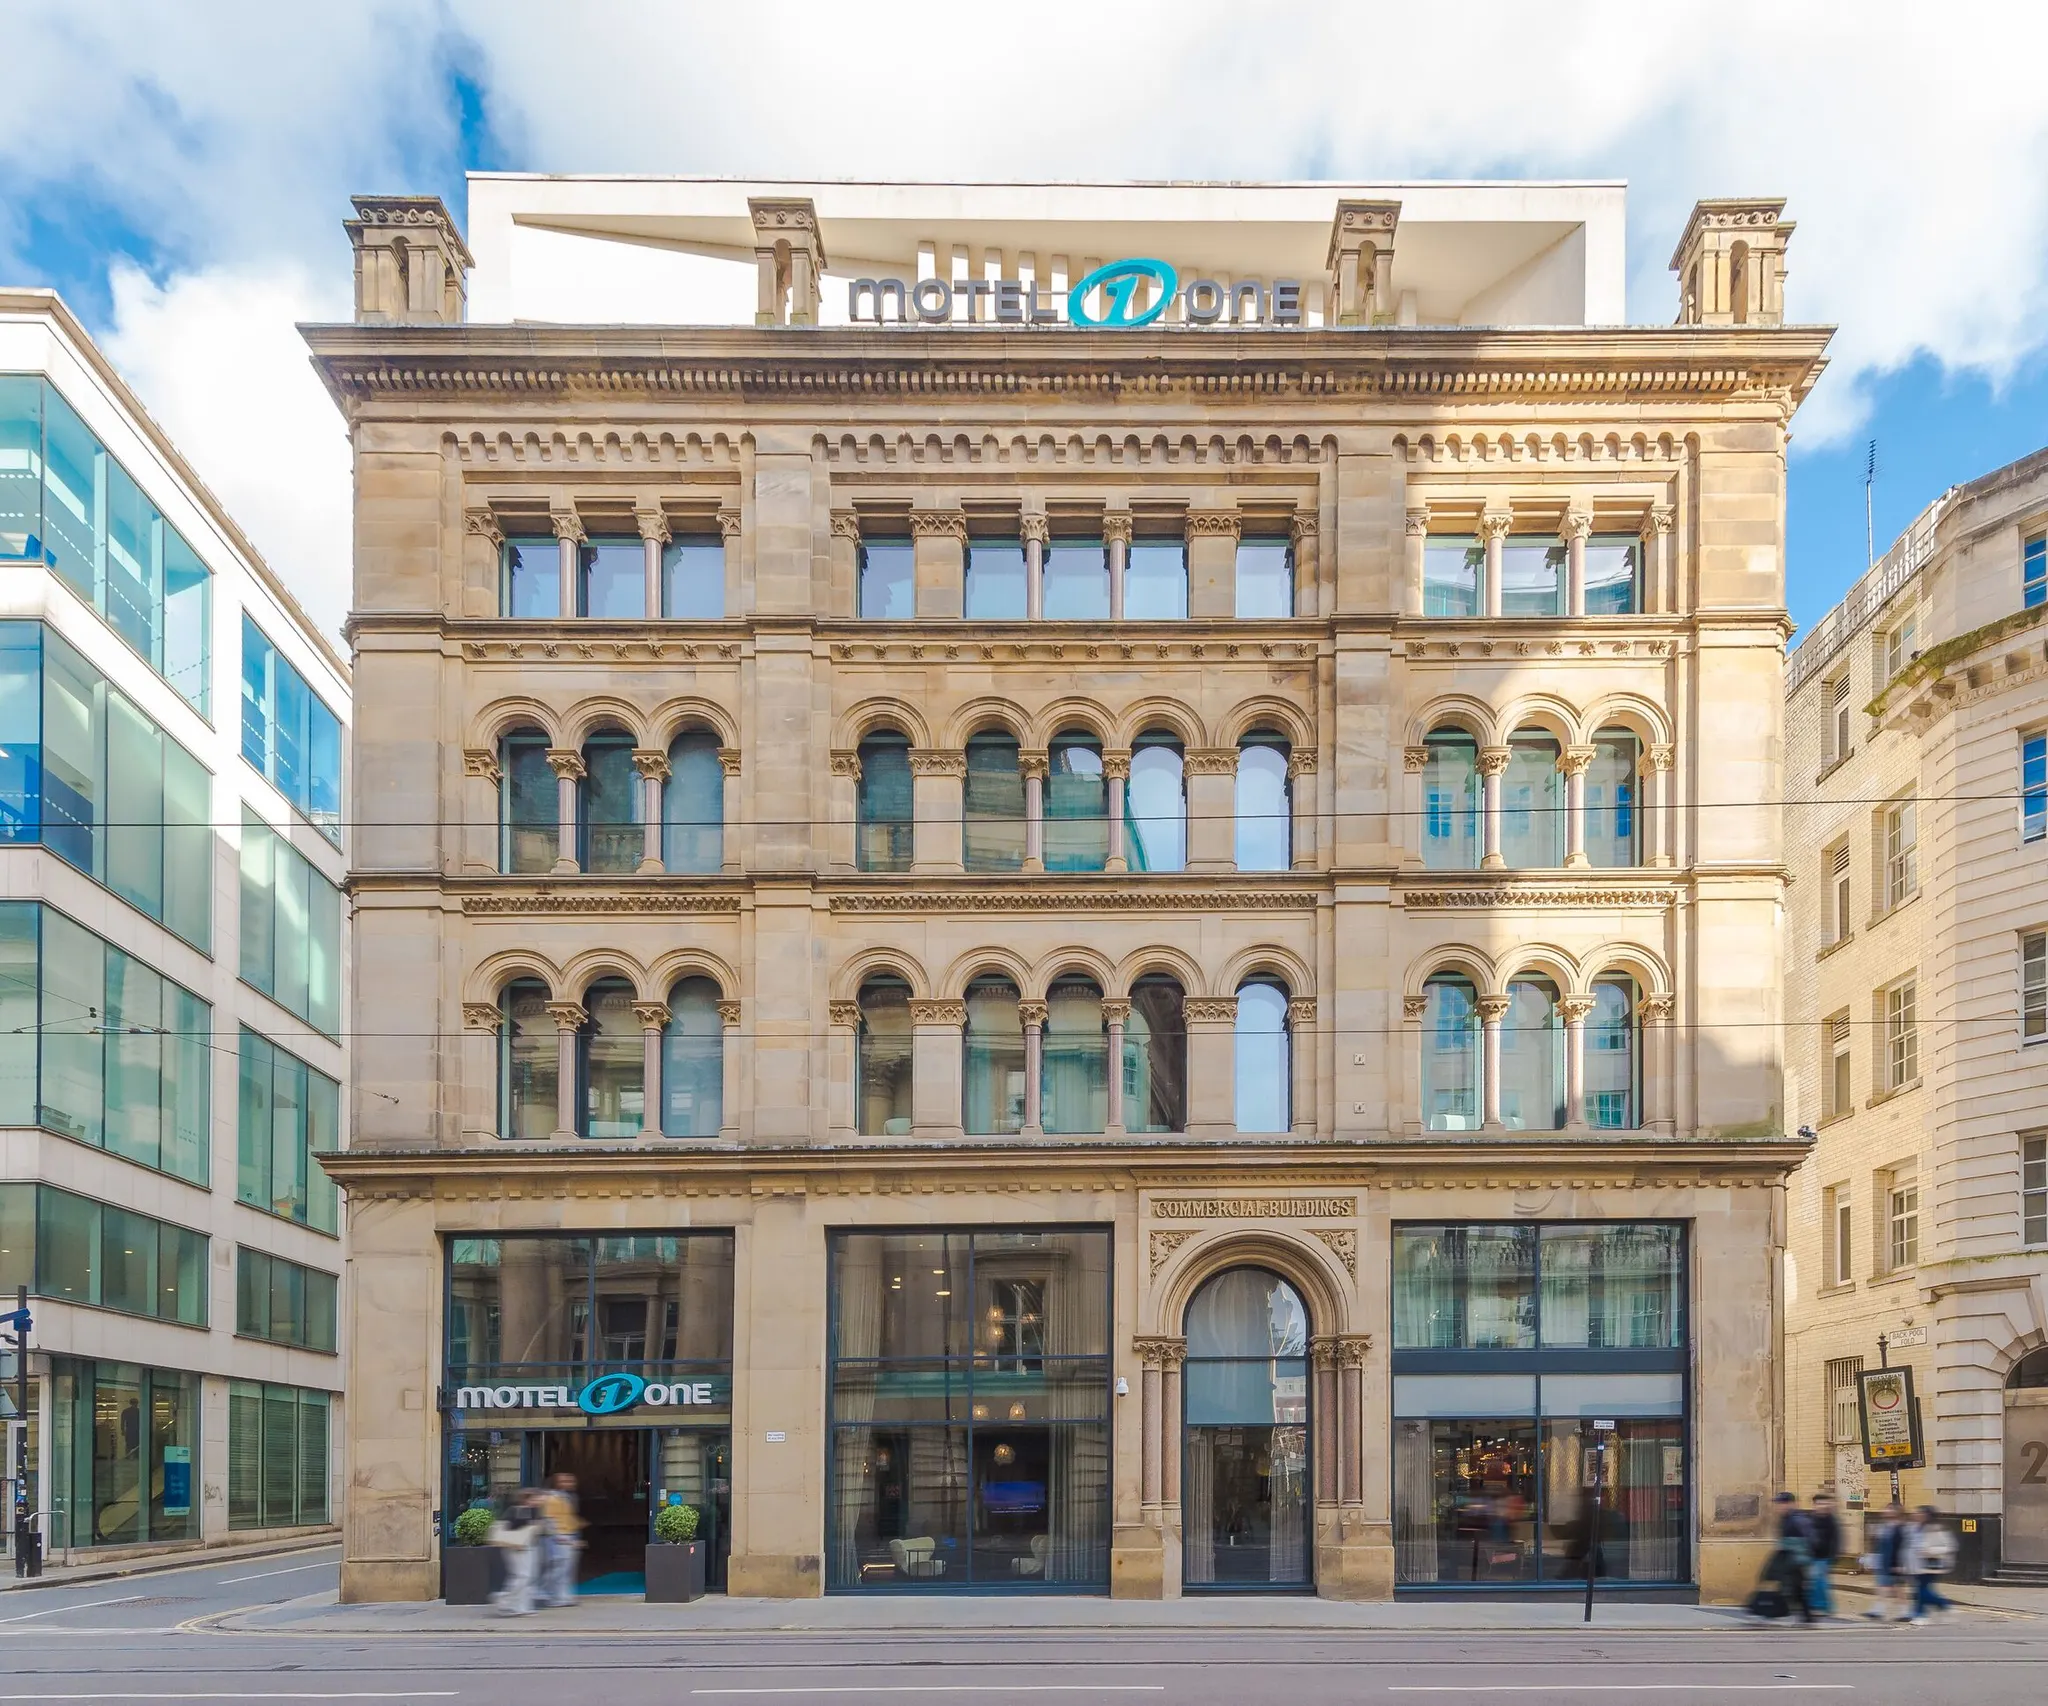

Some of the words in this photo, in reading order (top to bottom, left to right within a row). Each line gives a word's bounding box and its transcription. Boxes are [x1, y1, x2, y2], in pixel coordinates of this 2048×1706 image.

[849, 278, 1058, 324] MOTEL
[1185, 278, 1300, 325] ONE
[1155, 1200, 1266, 1218] COMMERCIAL
[1268, 1199, 1350, 1217] BUILDINGS
[1900, 1337, 1915, 1345] FOLD
[1908, 1329, 1924, 1337] POOL
[456, 1385, 578, 1409] MOTEL
[644, 1383, 713, 1406] ONE
[2020, 1441, 2048, 1484] 2
[1964, 1520, 1974, 1531] H
